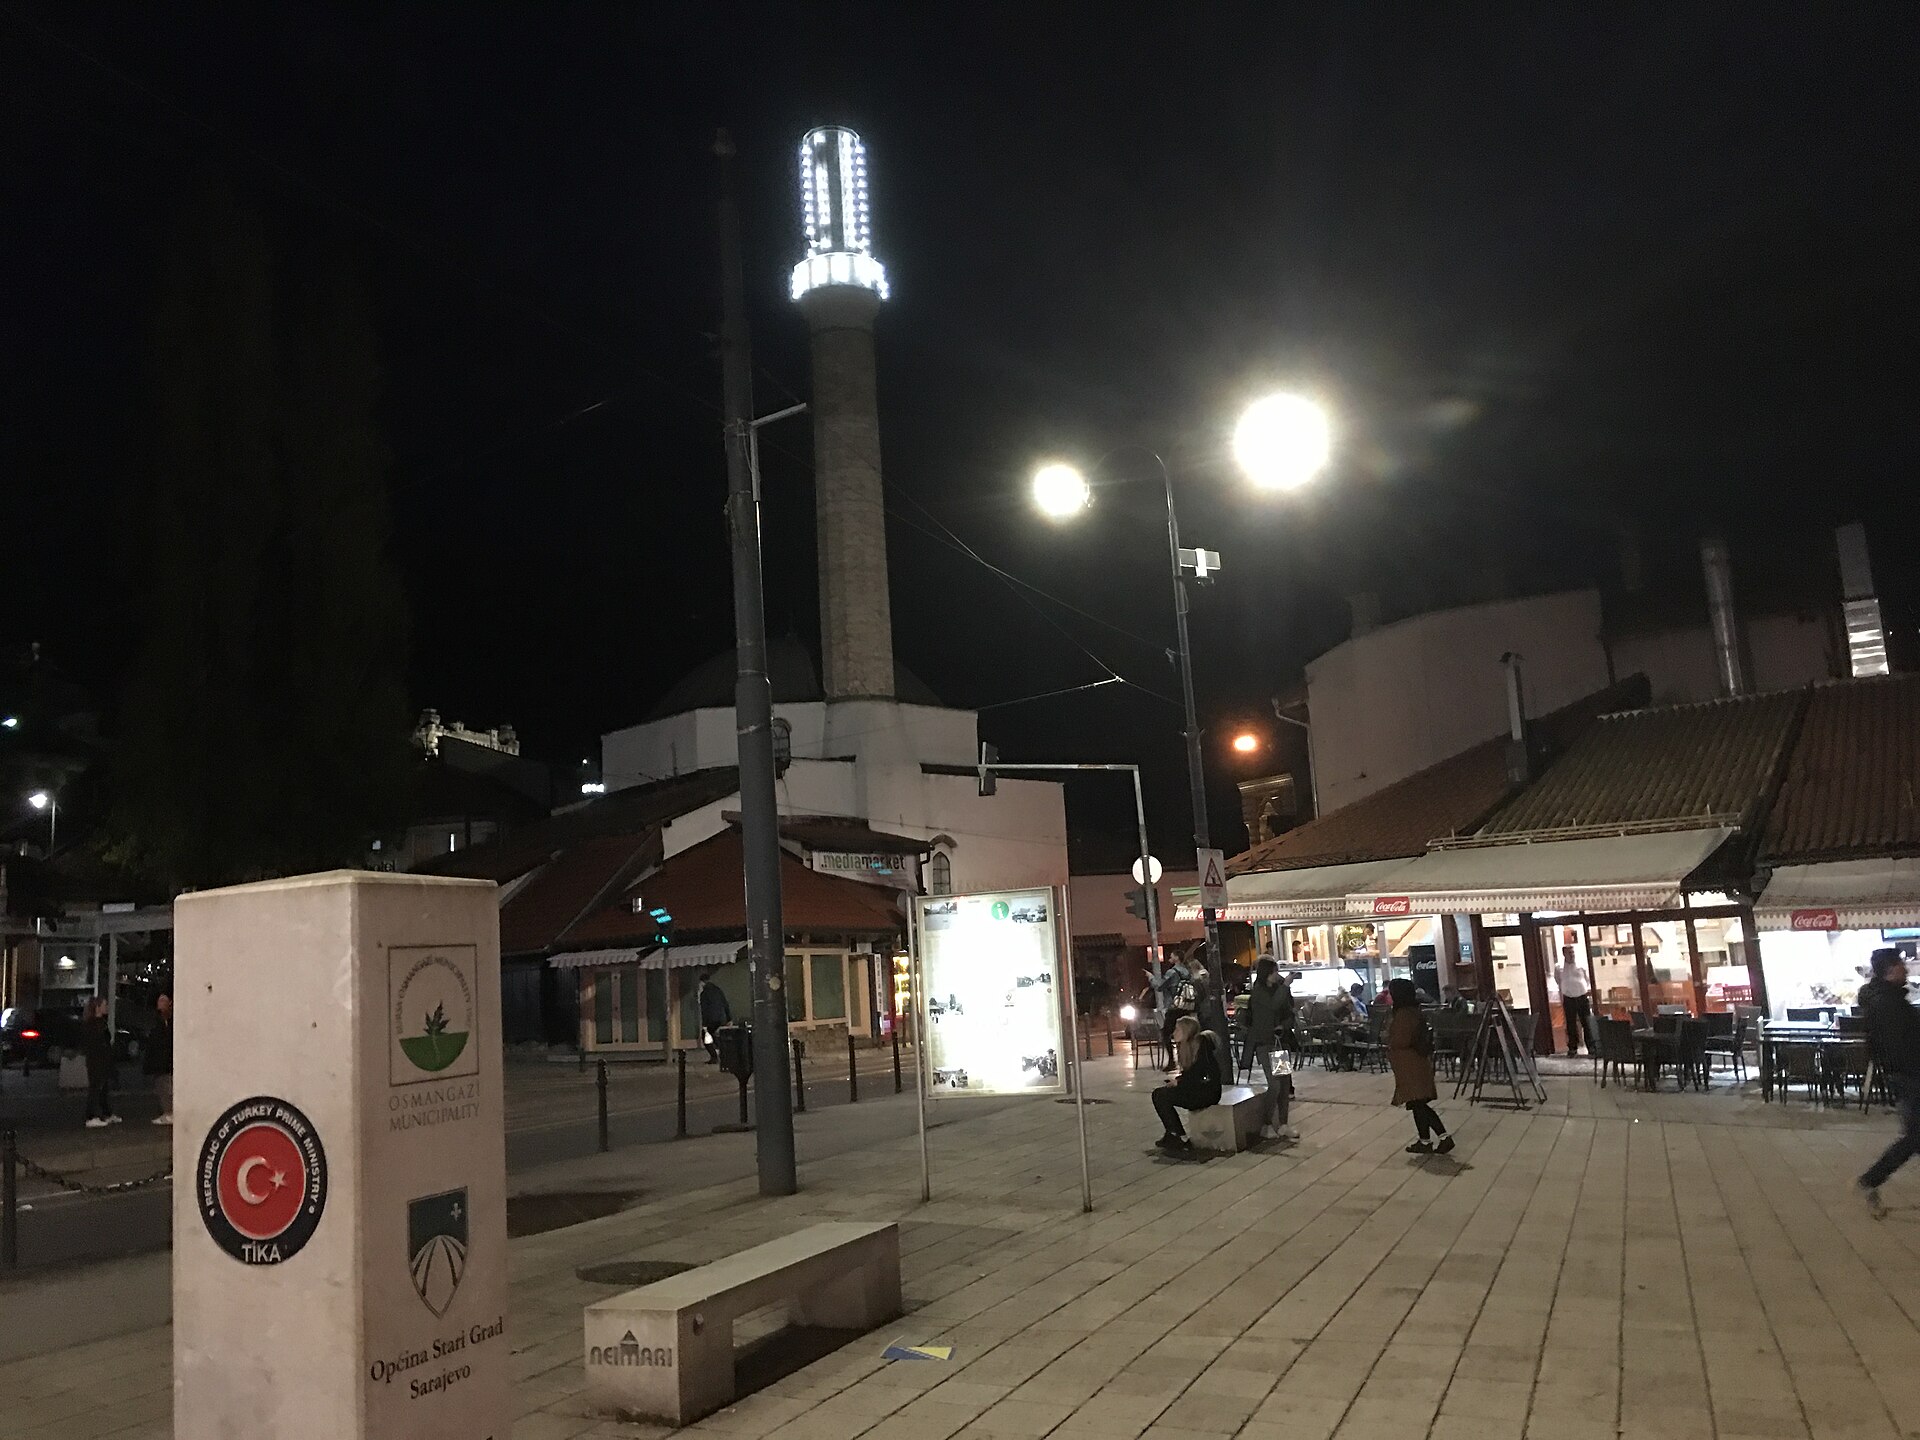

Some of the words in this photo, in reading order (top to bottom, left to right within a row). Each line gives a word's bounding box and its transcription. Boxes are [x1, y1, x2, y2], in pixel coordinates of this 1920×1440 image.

[389, 1102, 480, 1132] MUNICIPALITY
[204, 1139, 220, 1206] REPUBLIC
[218, 1123, 232, 1139] OF
[232, 1104, 275, 1125] TURKEY
[275, 1108, 307, 1138] PRIME
[303, 1138, 321, 1203] MINISTRY
[432, 1329, 466, 1359] Stari
[469, 1316, 503, 1345] Grad
[410, 1364, 471, 1399] Sarajevo
